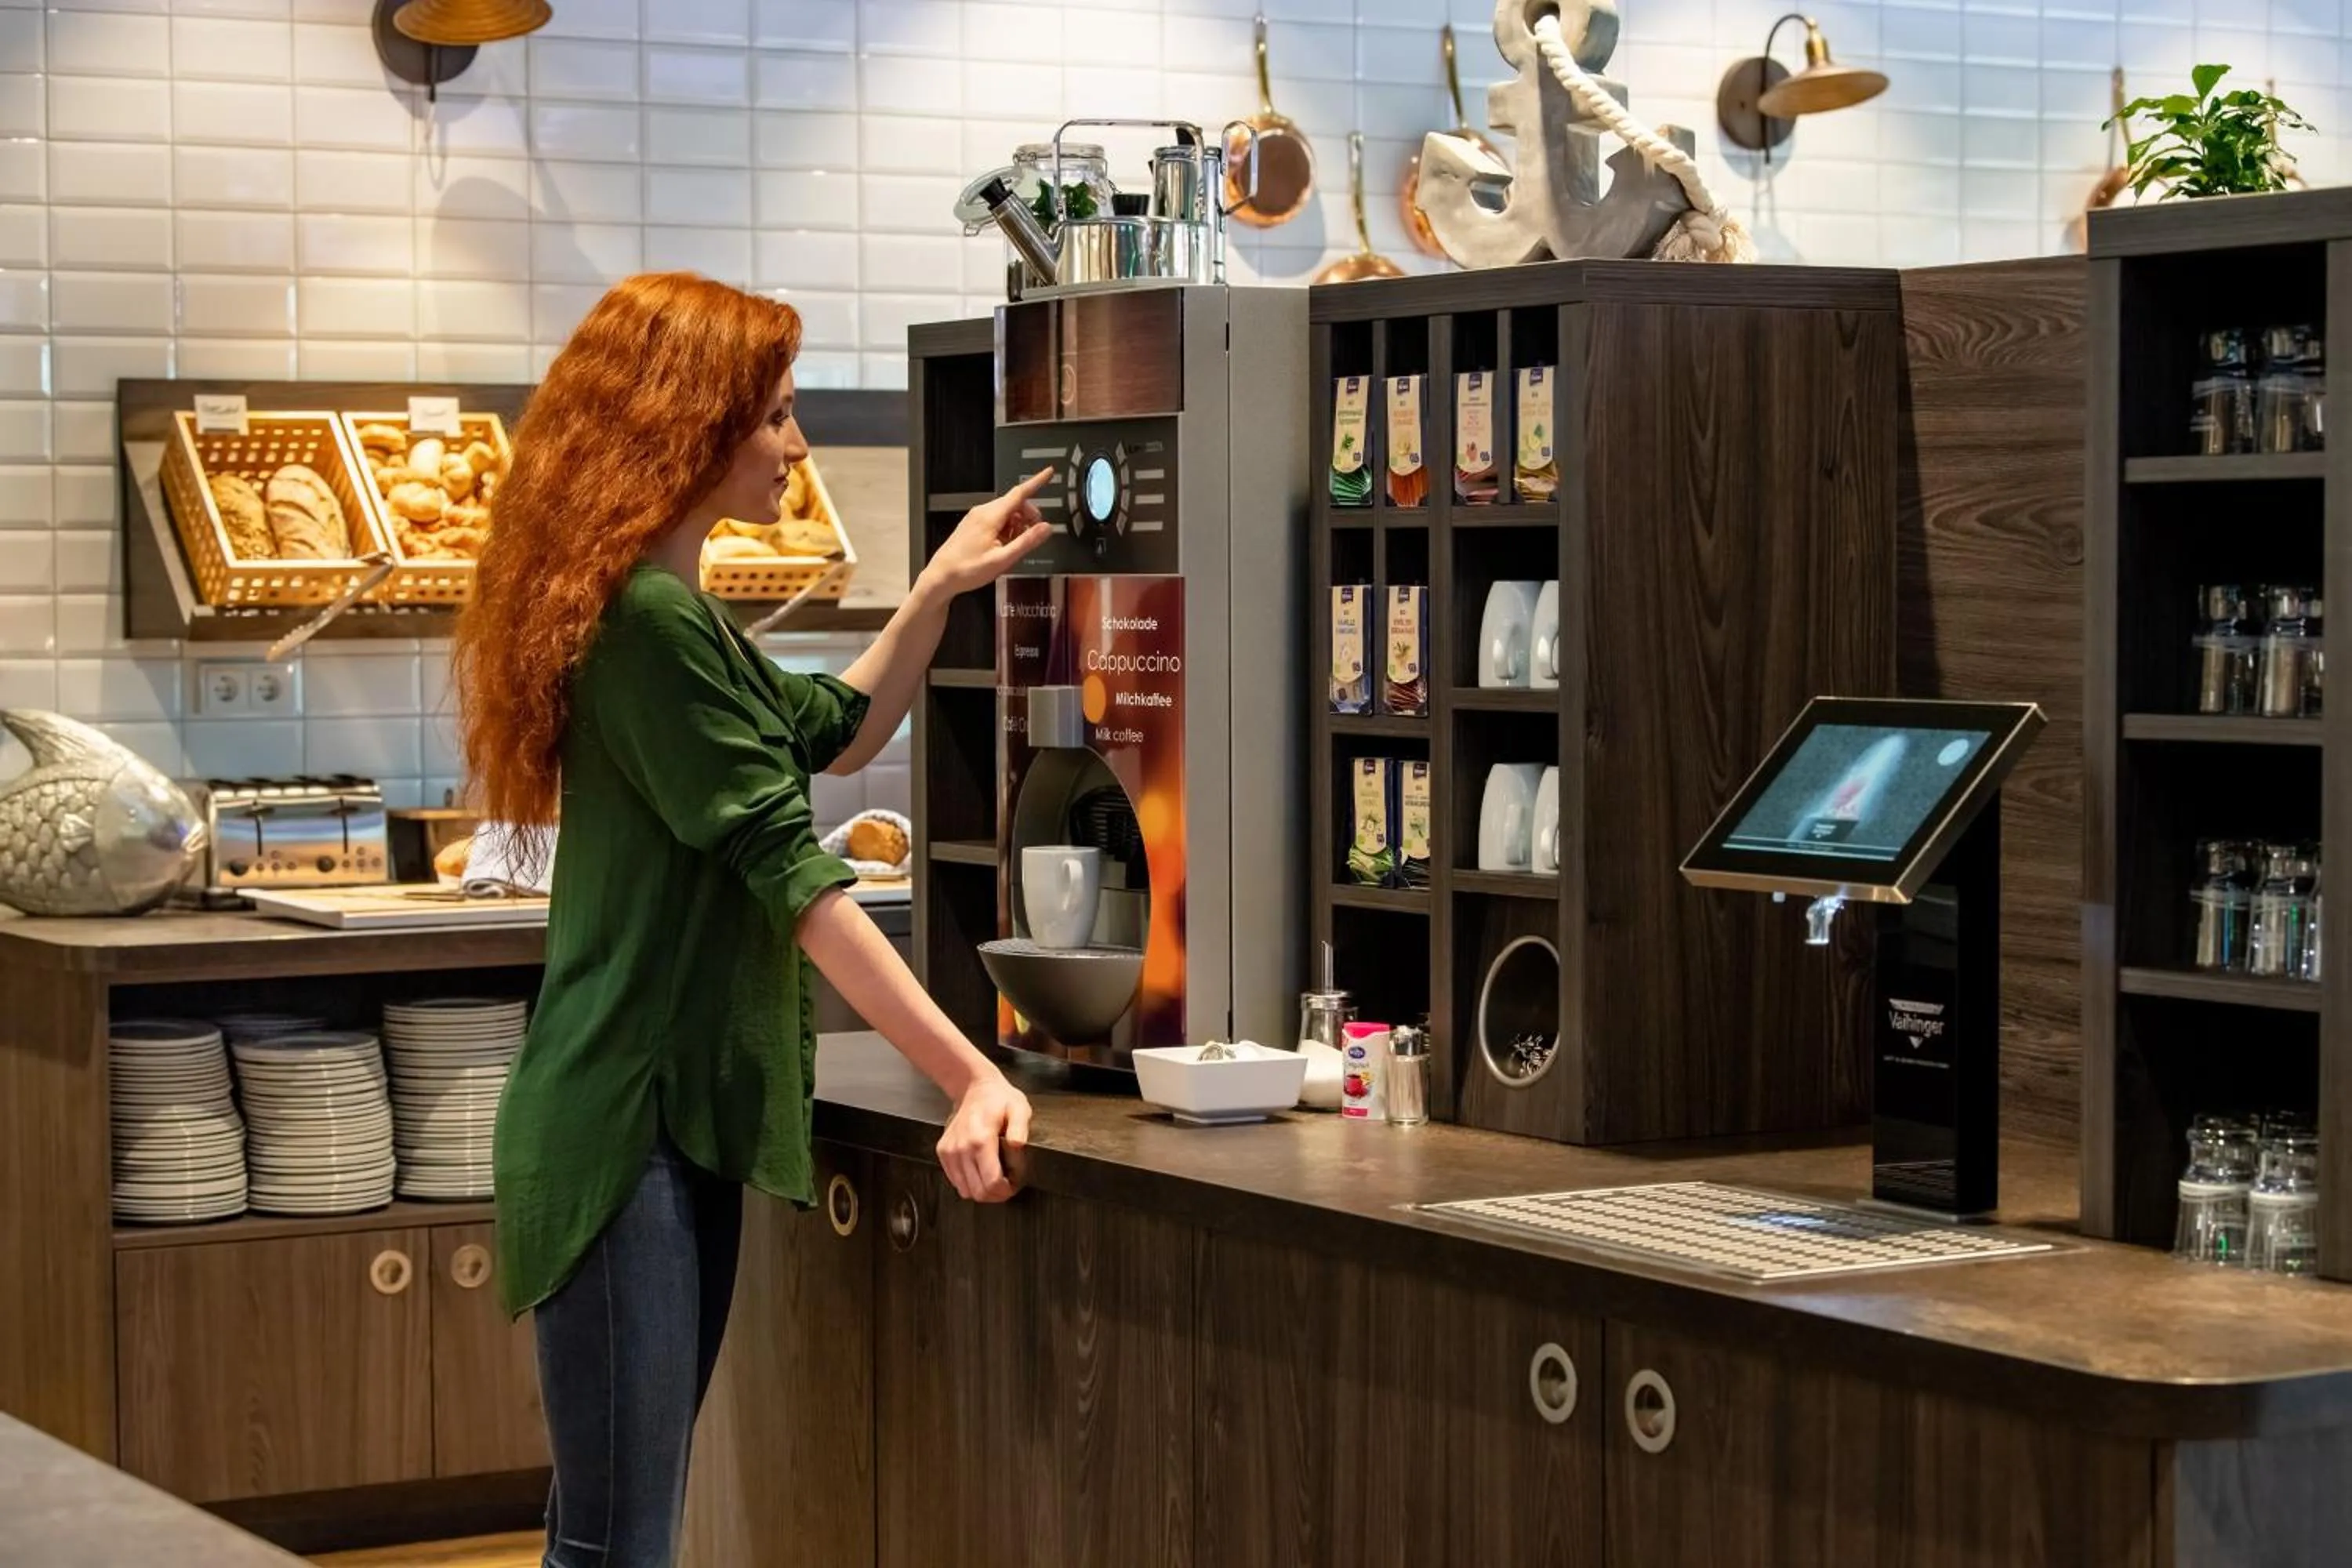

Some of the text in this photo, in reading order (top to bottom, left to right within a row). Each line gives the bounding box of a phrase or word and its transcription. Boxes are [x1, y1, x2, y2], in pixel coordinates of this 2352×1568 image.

[1101, 615, 1158, 630] Schokolade
[1087, 649, 1181, 675] Cappuccino
[1115, 691, 1172, 707] Milchkaffee
[1094, 727, 1144, 742] Milk coffee
